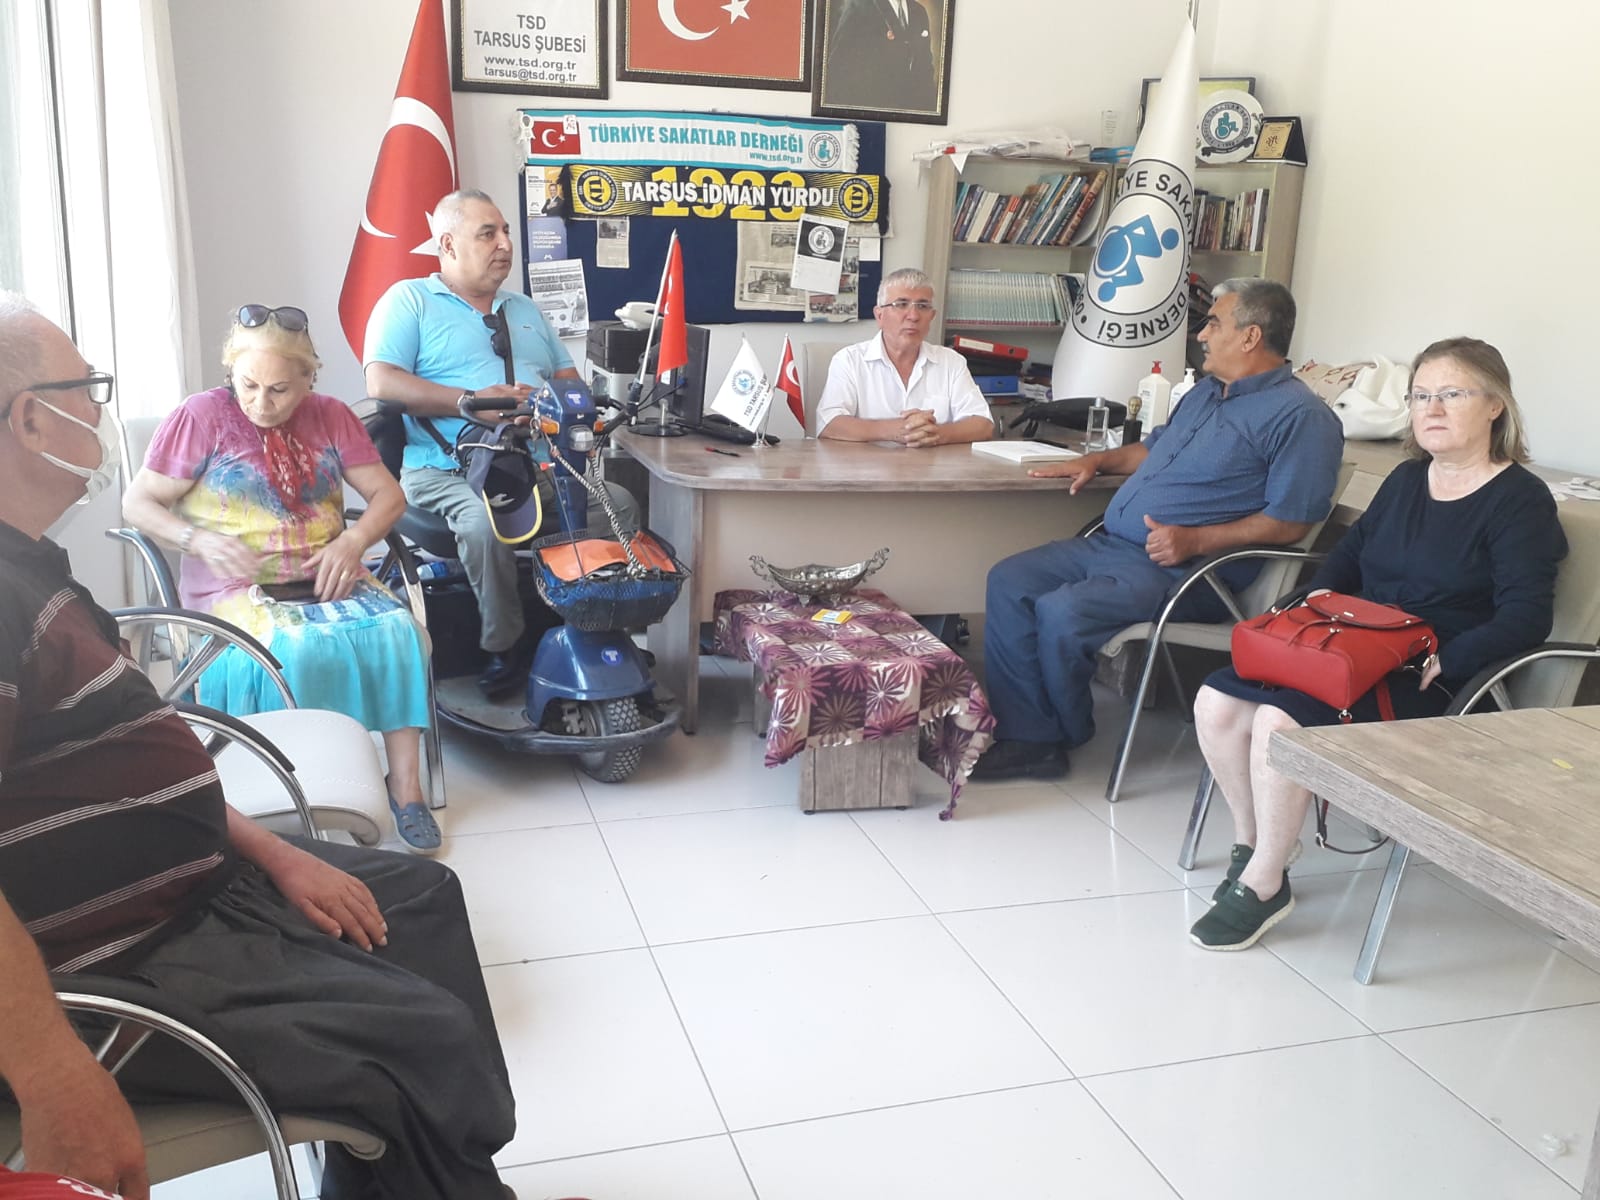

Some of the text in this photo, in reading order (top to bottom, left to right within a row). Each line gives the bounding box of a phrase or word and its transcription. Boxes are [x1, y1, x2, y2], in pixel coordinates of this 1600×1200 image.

[516, 14, 546, 30] TSD
[474, 30, 586, 54] TARSUS ŞUBESİ
[484, 55, 577, 72] www.tsd.org.tr
[484, 66, 577, 83] tarsus@tsd.org.tr
[588, 123, 655, 143] TÜRKİYE
[659, 126, 736, 147] SAKATLAR
[741, 131, 803, 153] DERNEĞİ
[749, 151, 803, 164] www.tsd.org.tr
[621, 182, 698, 203] TARSUS
[702, 183, 766, 206] İDMAN
[770, 187, 834, 207] YURDU
[1097, 292, 1186, 342] DERNEĞİ
